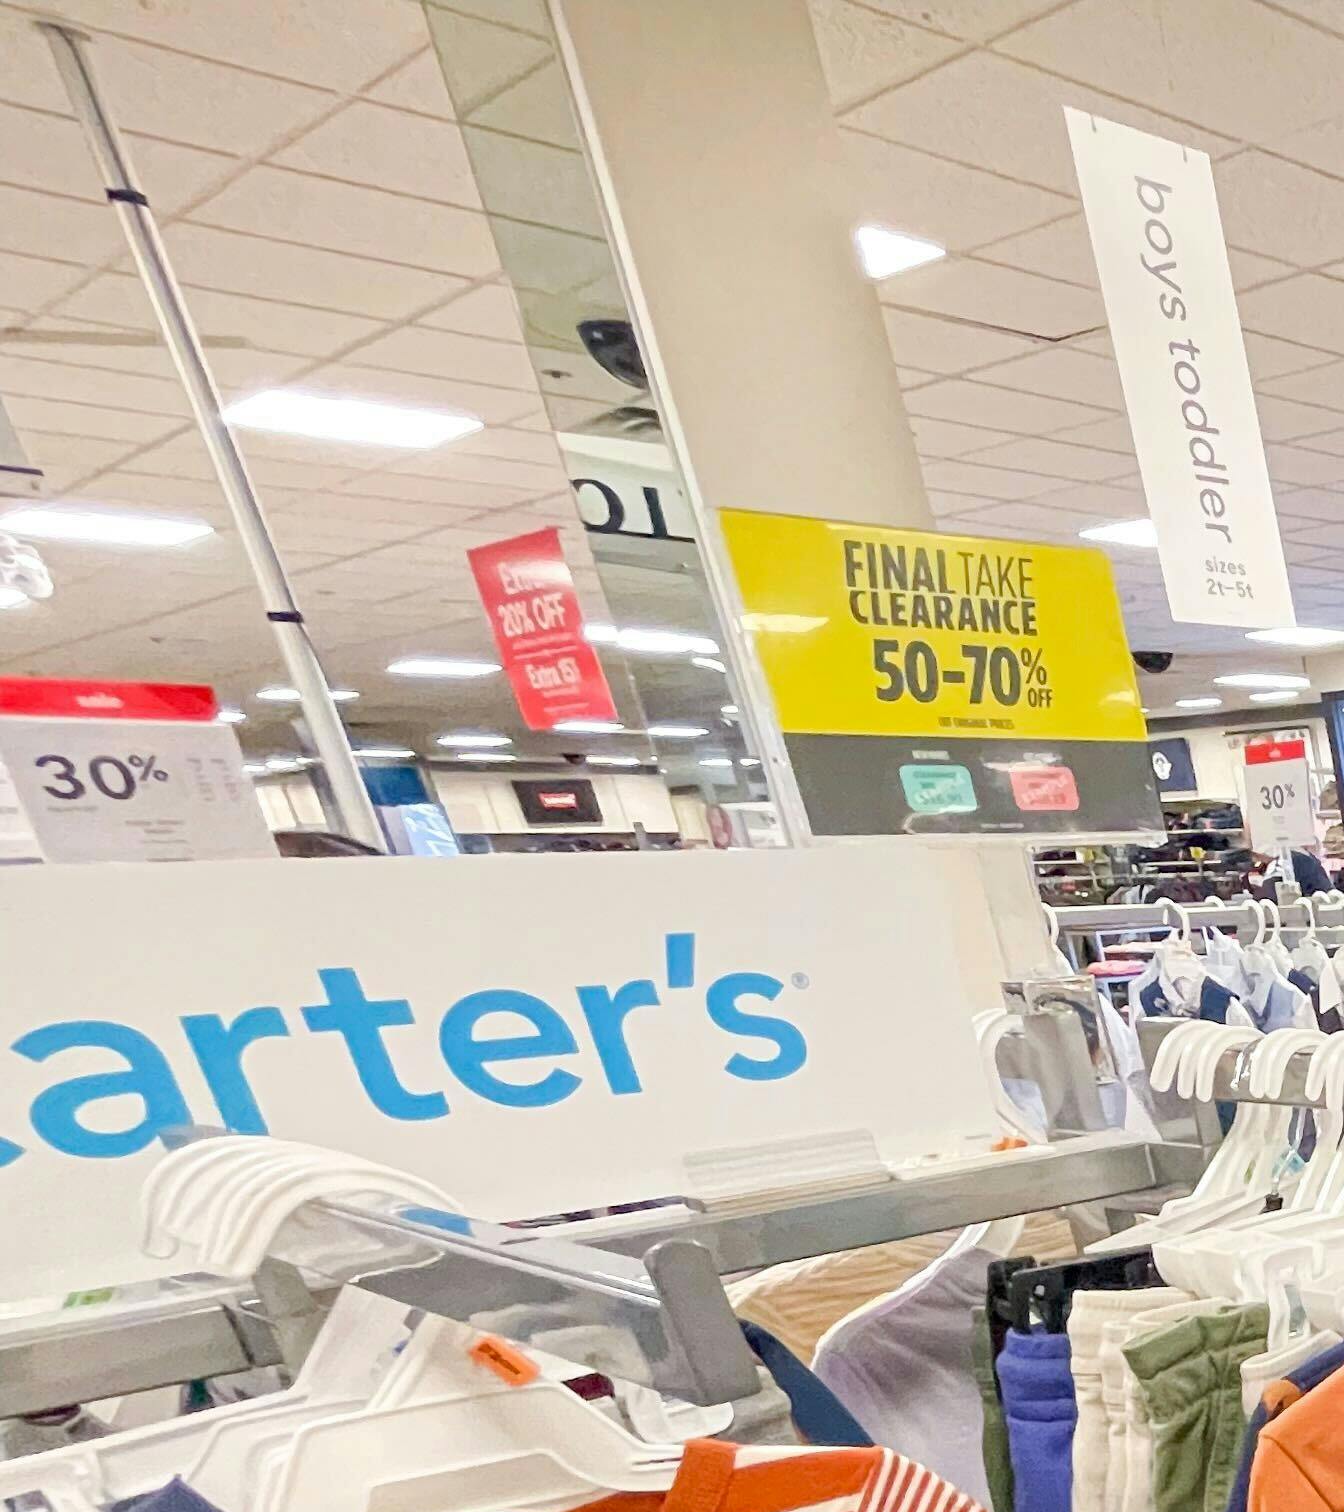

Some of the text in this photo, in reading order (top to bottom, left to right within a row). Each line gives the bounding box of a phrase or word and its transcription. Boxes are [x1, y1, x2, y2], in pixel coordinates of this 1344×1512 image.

[1134, 174, 1233, 544] boys toddler
[843, 539, 1034, 600] FINAL TAKE
[1205, 557, 1247, 577] sizes
[533, 592, 566, 631] OFF
[849, 590, 1039, 637] CLEARANCE
[1027, 687, 1054, 710] OFF
[35, 753, 169, 801] 30%
[1260, 783, 1296, 811] 30%
[0, 932, 808, 1170] arter's
